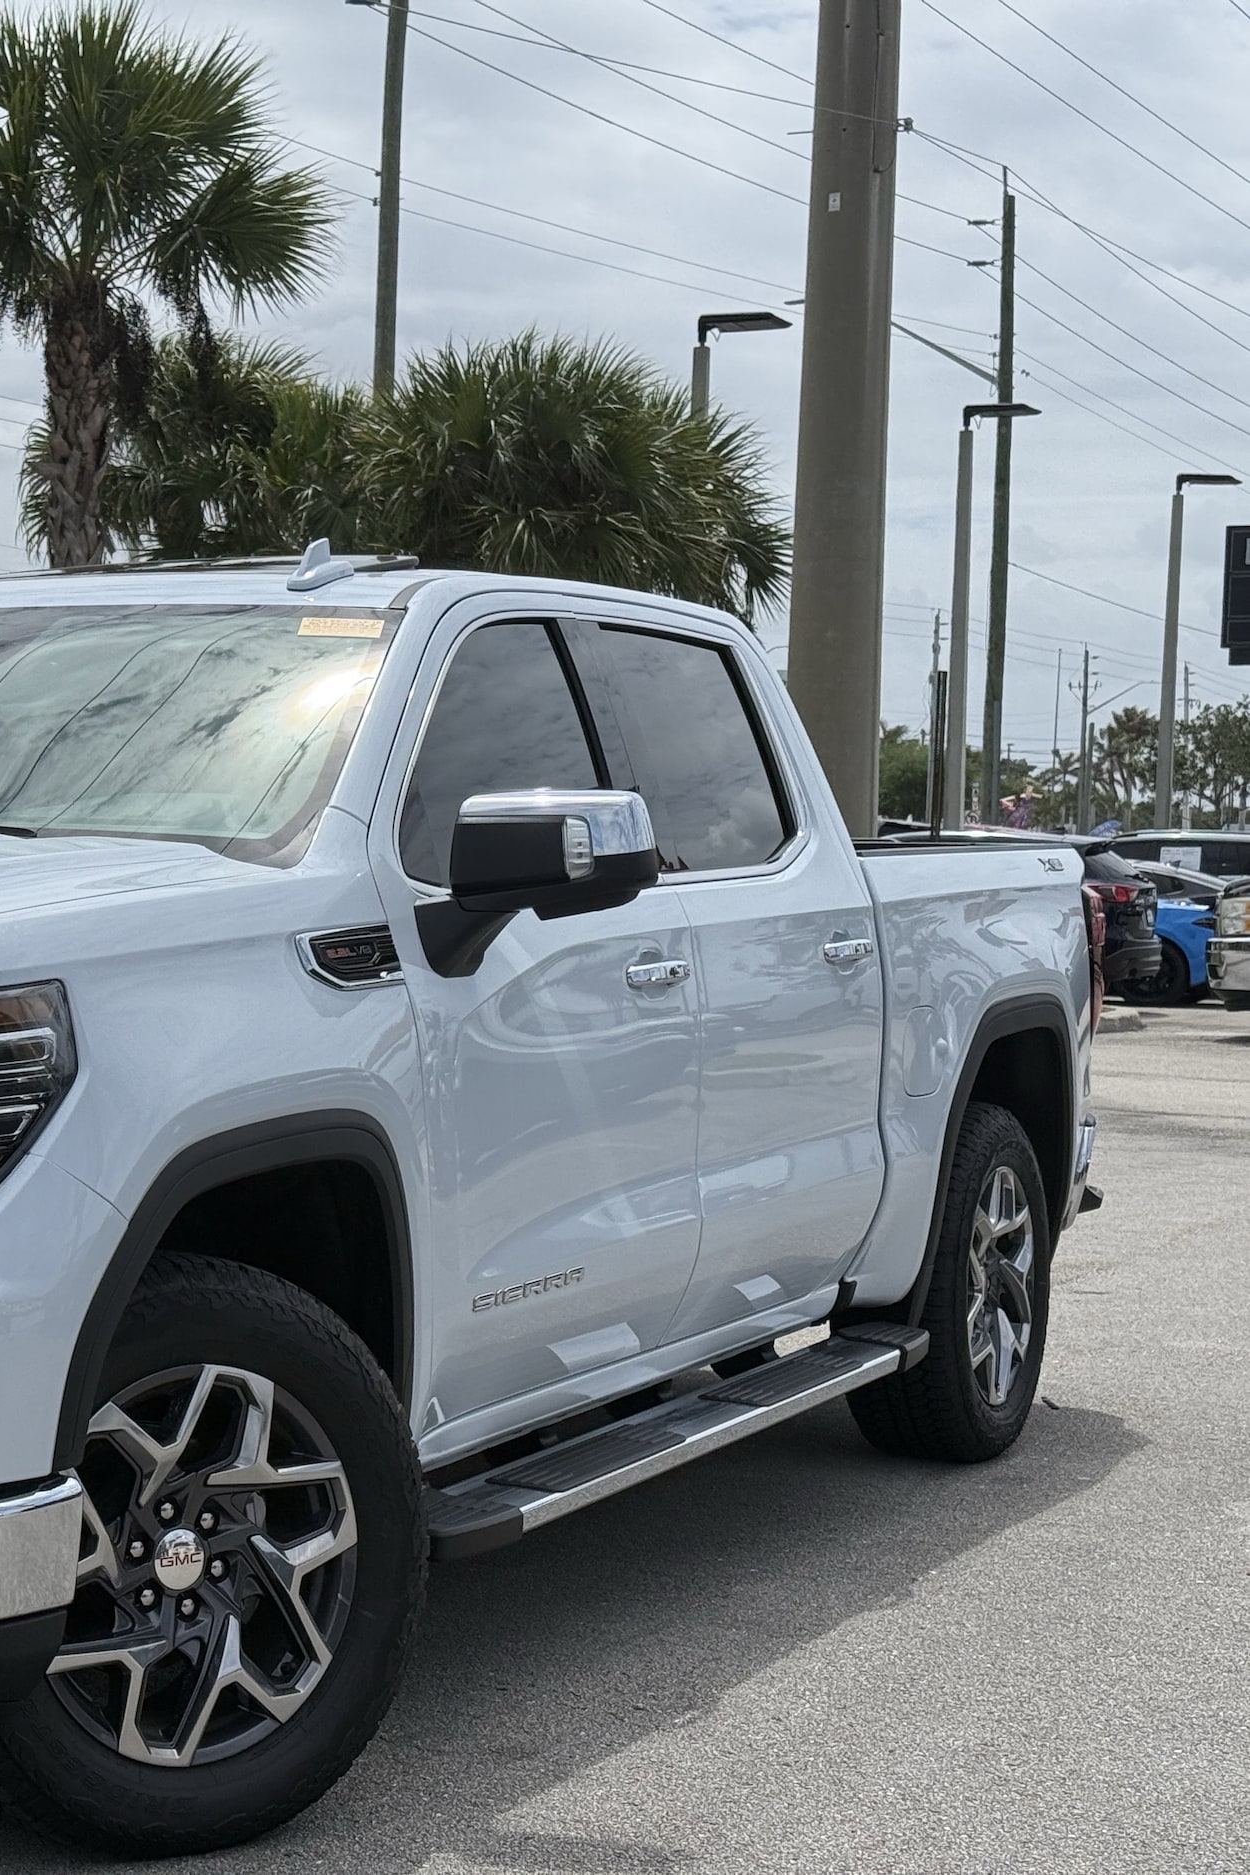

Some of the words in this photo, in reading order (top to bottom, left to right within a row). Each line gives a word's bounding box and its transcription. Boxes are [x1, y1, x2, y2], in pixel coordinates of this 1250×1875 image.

[353, 944, 372, 955] V8
[472, 1265, 585, 1312] SIERRA
[160, 1552, 202, 1568] GMC
